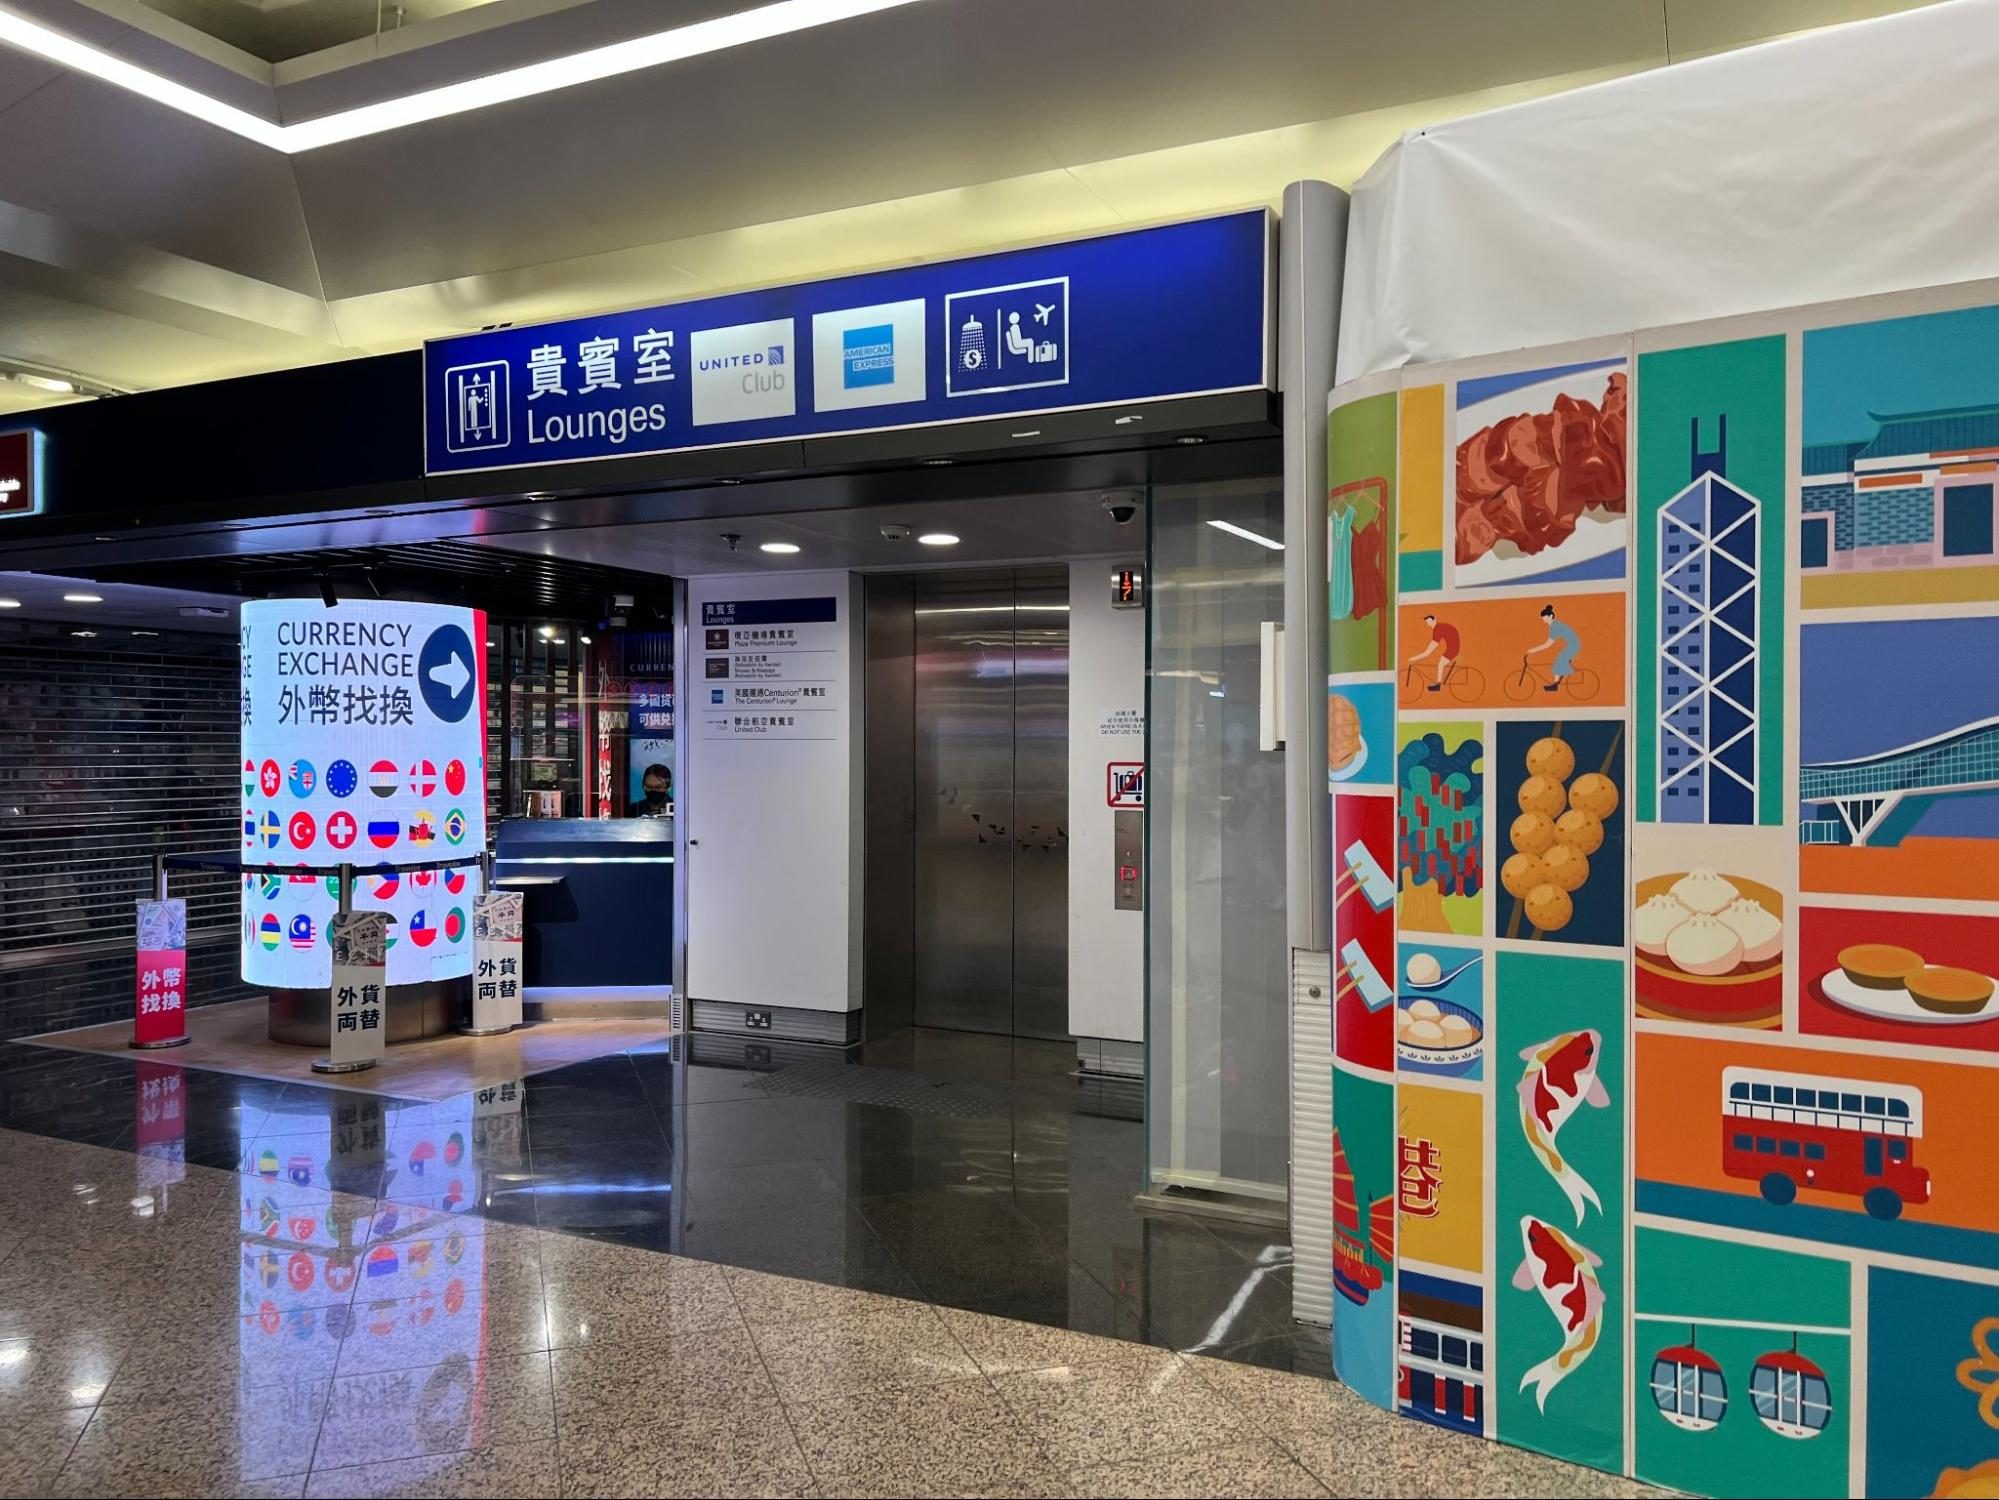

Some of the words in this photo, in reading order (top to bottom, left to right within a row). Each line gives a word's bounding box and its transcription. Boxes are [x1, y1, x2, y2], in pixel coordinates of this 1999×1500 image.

[700, 353, 763, 371] UNITED
[844, 344, 890, 358] AMERICAN
[526, 328, 675, 400] 貴賓室
[854, 357, 895, 371] EXPRESS
[742, 371, 785, 394] Club
[528, 403, 666, 443] Lounges
[706, 616, 734, 624] Lounges
[277, 621, 412, 648] CURRENCY
[277, 652, 414, 678] EXCHANGE
[278, 684, 415, 726] 外幣找換
[142, 968, 181, 990] 外幣
[478, 958, 517, 977] 外貨
[337, 984, 380, 1007] 外貨
[478, 980, 517, 1000] 両替
[141, 991, 181, 1014] 找換
[337, 1009, 380, 1032] 両替
